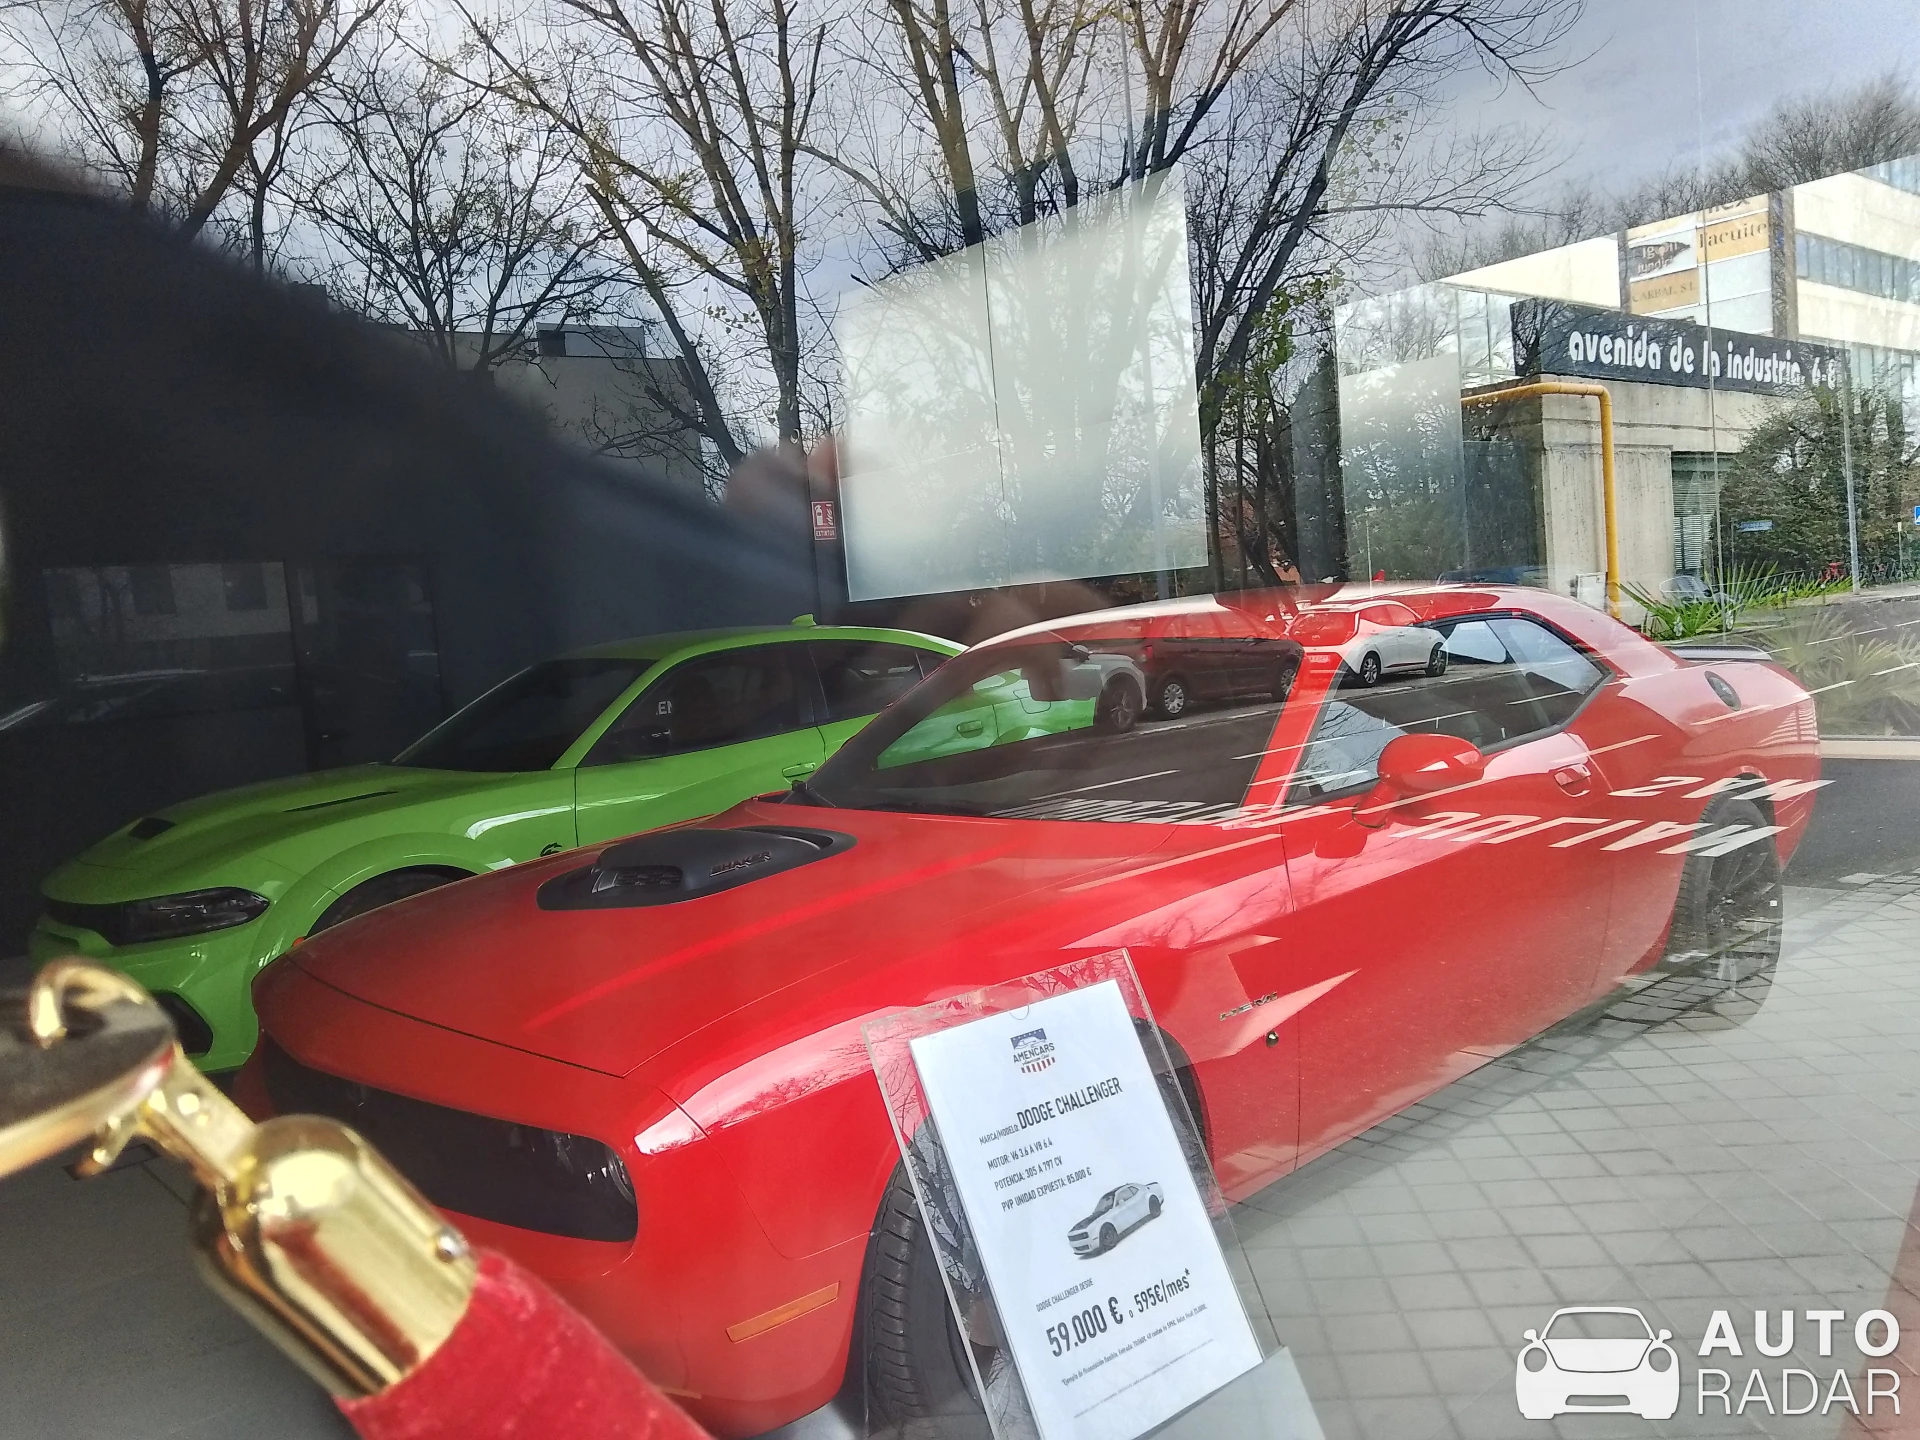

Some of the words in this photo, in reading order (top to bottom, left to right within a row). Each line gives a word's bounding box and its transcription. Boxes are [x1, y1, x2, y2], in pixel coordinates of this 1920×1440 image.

[1569, 325, 1661, 370] avenida
[1670, 336, 1695, 373] de
[1702, 340, 1721, 377] la
[1013, 1042, 1055, 1063] AMENCARS
[979, 1124, 1020, 1145] MARCA/MODELO:
[1016, 1101, 1055, 1129] DODGE
[1055, 1077, 1123, 1115] CHALLENGER
[987, 1154, 1011, 1170] MOTOR:
[1010, 1149, 1018, 1161] V6
[1019, 1147, 1029, 1158] 3.6
[1029, 1144, 1035, 1154] A
[1034, 1141, 1043, 1151] V8
[1043, 1137, 1053, 1149] 6.4
[994, 1172, 1025, 1191] POTENCIA:
[1025, 1166, 1037, 1179] 305
[1038, 1164, 1043, 1173] A
[1043, 1160, 1054, 1171] 797
[1054, 1156, 1063, 1166] CV
[1001, 1198, 1014, 1212] PVP
[1014, 1190, 1036, 1207] UNIDAD
[1036, 1178, 1067, 1198] EXPUESTA:
[1066, 1169, 1086, 1185] 85.000
[1086, 1167, 1092, 1176] €
[1036, 1299, 1052, 1312] DODGE
[1051, 1285, 1079, 1304] CHALLENGER
[1079, 1278, 1094, 1291] DESDE
[1046, 1304, 1108, 1357] 59.000
[1108, 1296, 1123, 1325] €
